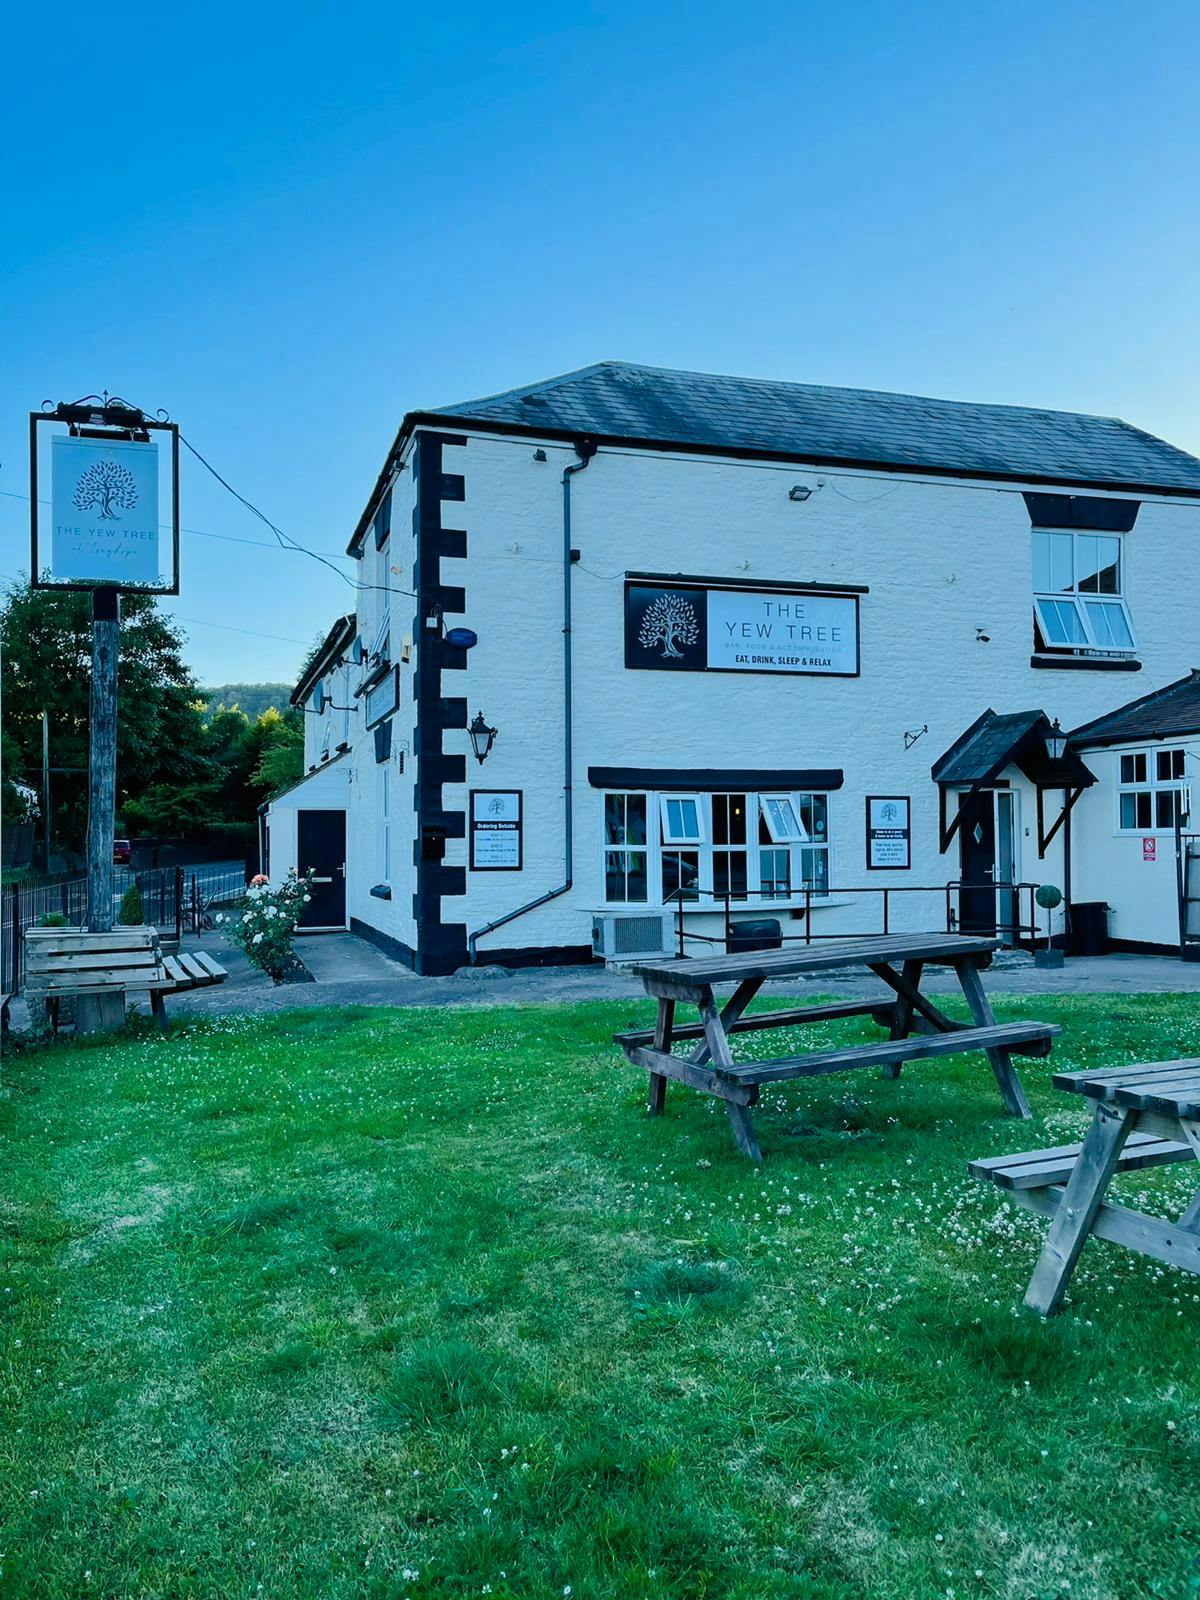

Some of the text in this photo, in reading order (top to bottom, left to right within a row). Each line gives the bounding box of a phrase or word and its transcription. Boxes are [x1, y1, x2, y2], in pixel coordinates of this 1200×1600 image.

[56, 526, 156, 541] THE YEW TREE
[763, 601, 805, 619] THE
[725, 621, 841, 642] YEW TREE
[777, 644, 842, 654] ACCOMMODATION
[735, 654, 832, 667] EAT, DRINK, SLEEP & RELAX
